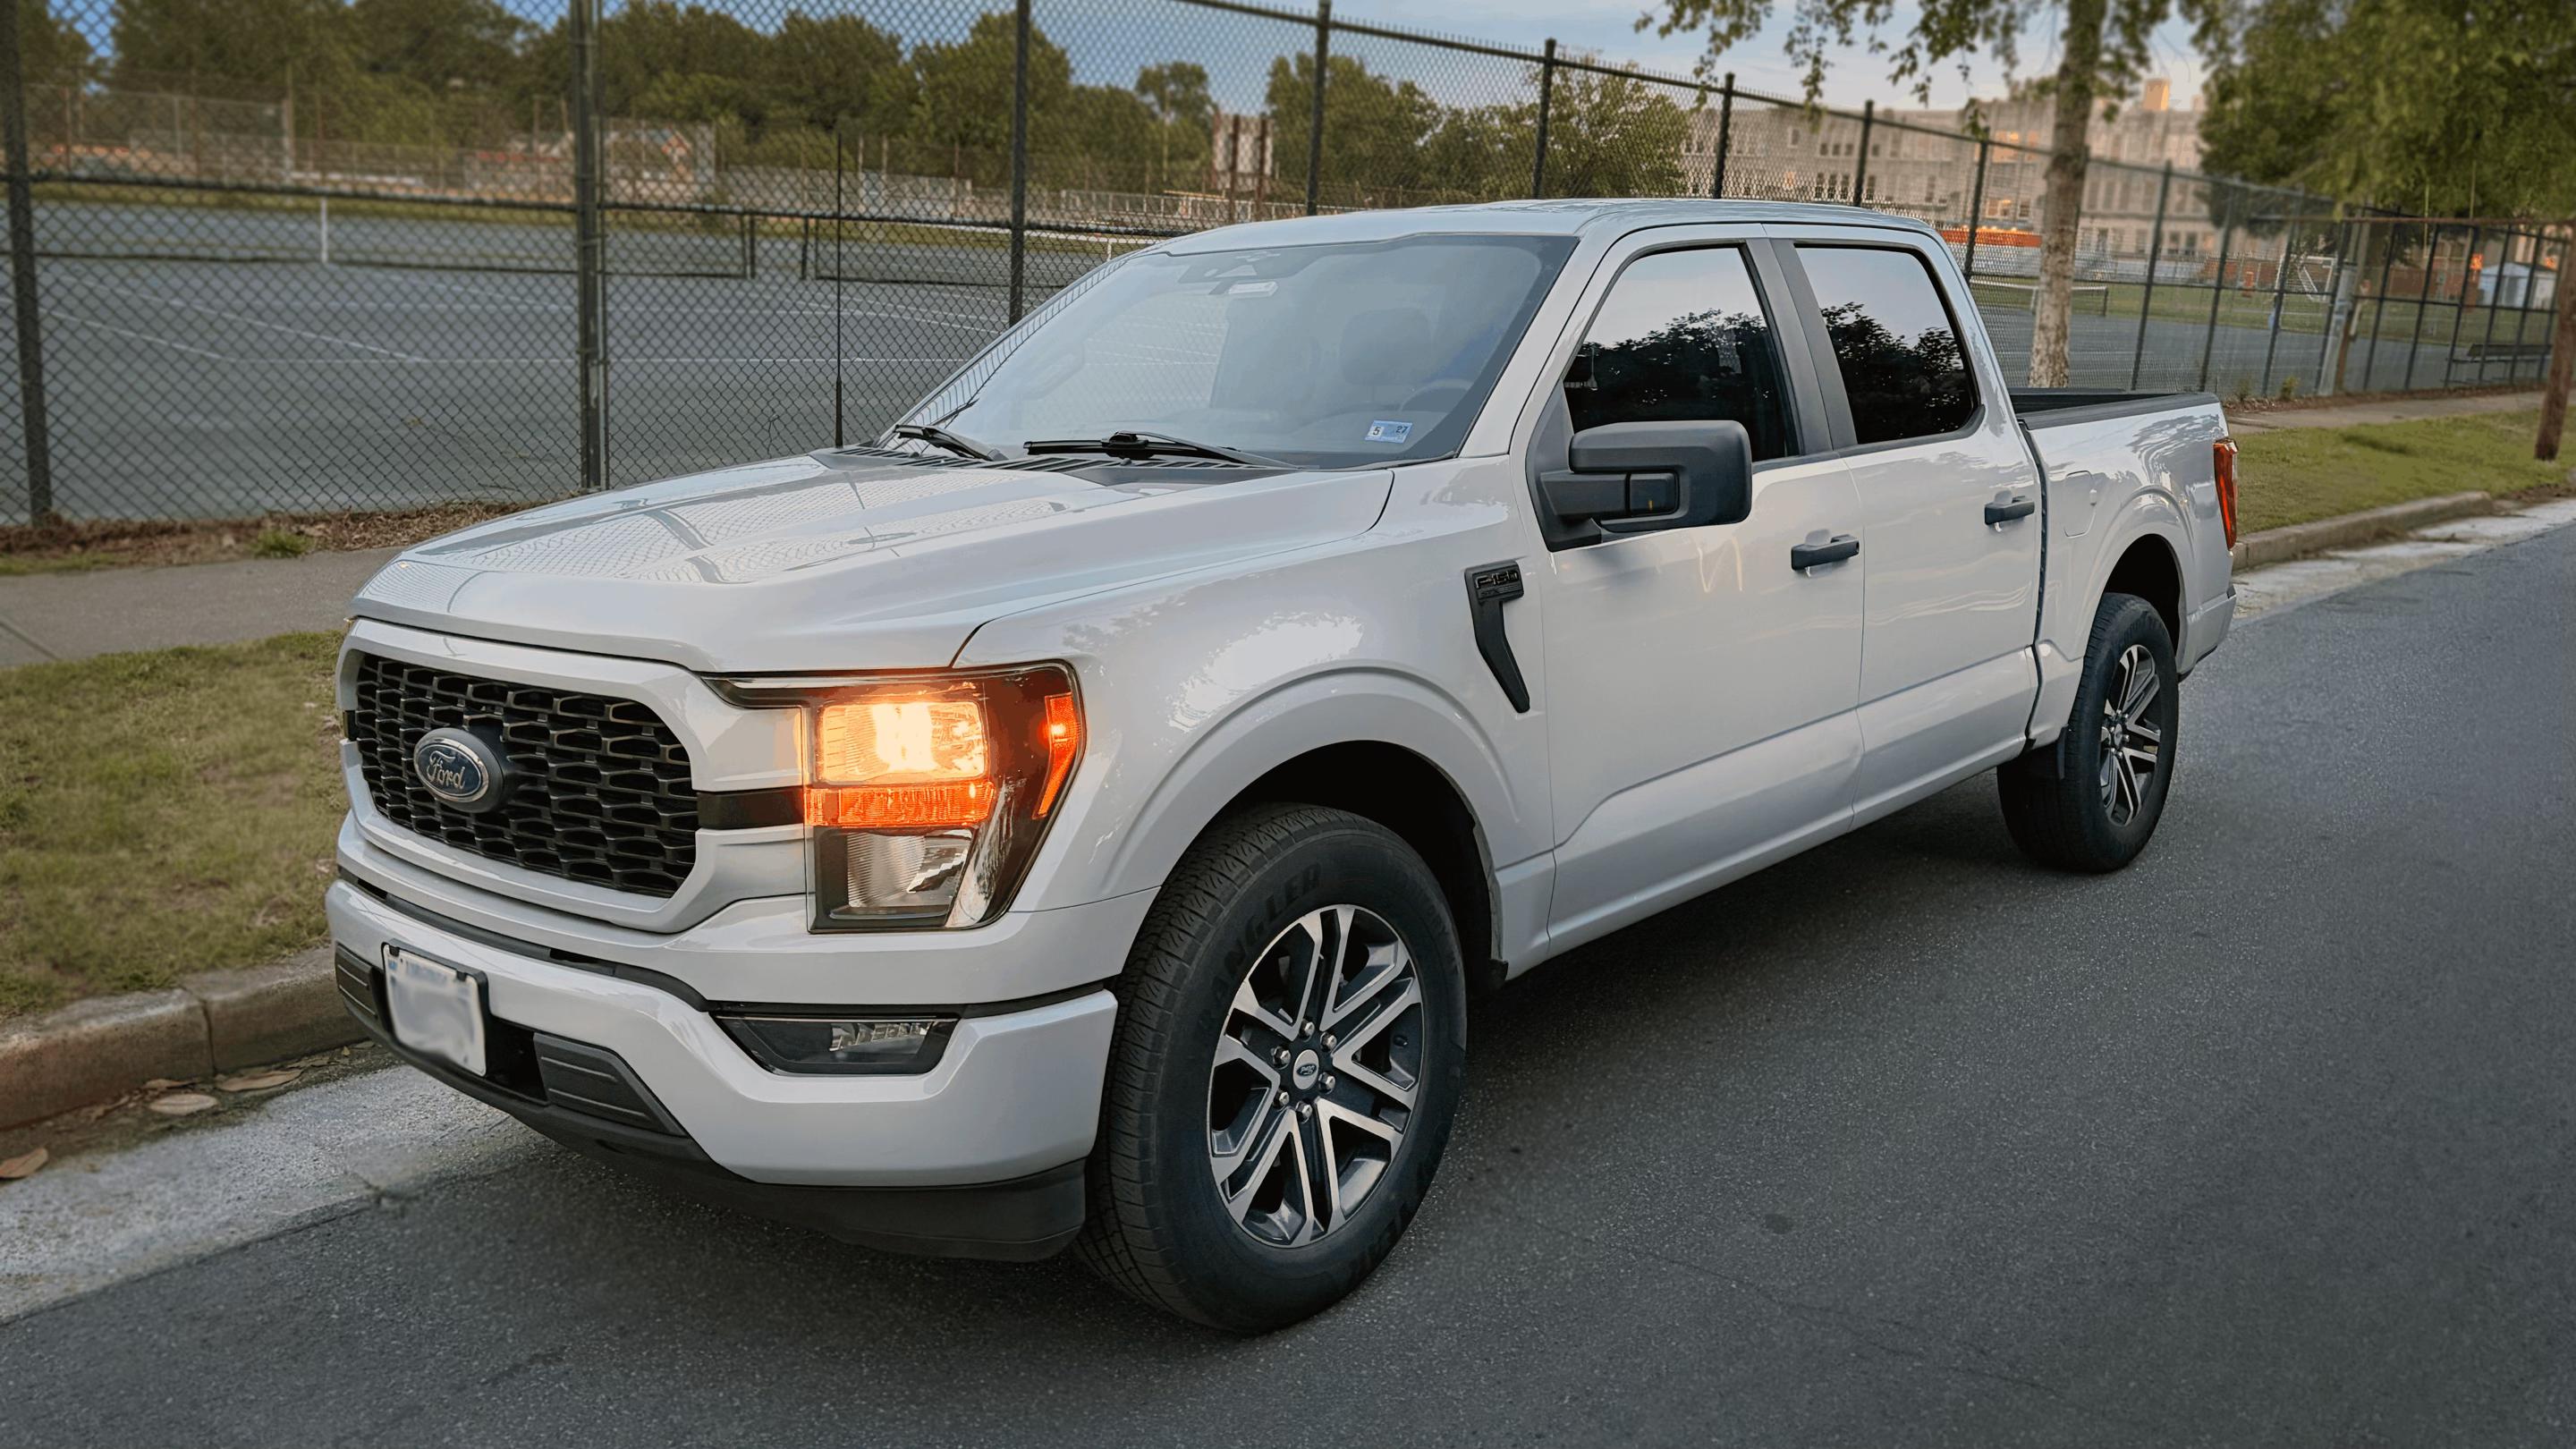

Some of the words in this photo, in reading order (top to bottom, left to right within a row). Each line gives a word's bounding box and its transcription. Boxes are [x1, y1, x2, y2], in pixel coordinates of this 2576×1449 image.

[1372, 426, 1381, 436] 5
[1395, 425, 1409, 434] 27
[1474, 570, 1519, 589] F-150
[427, 750, 466, 790] Ford
